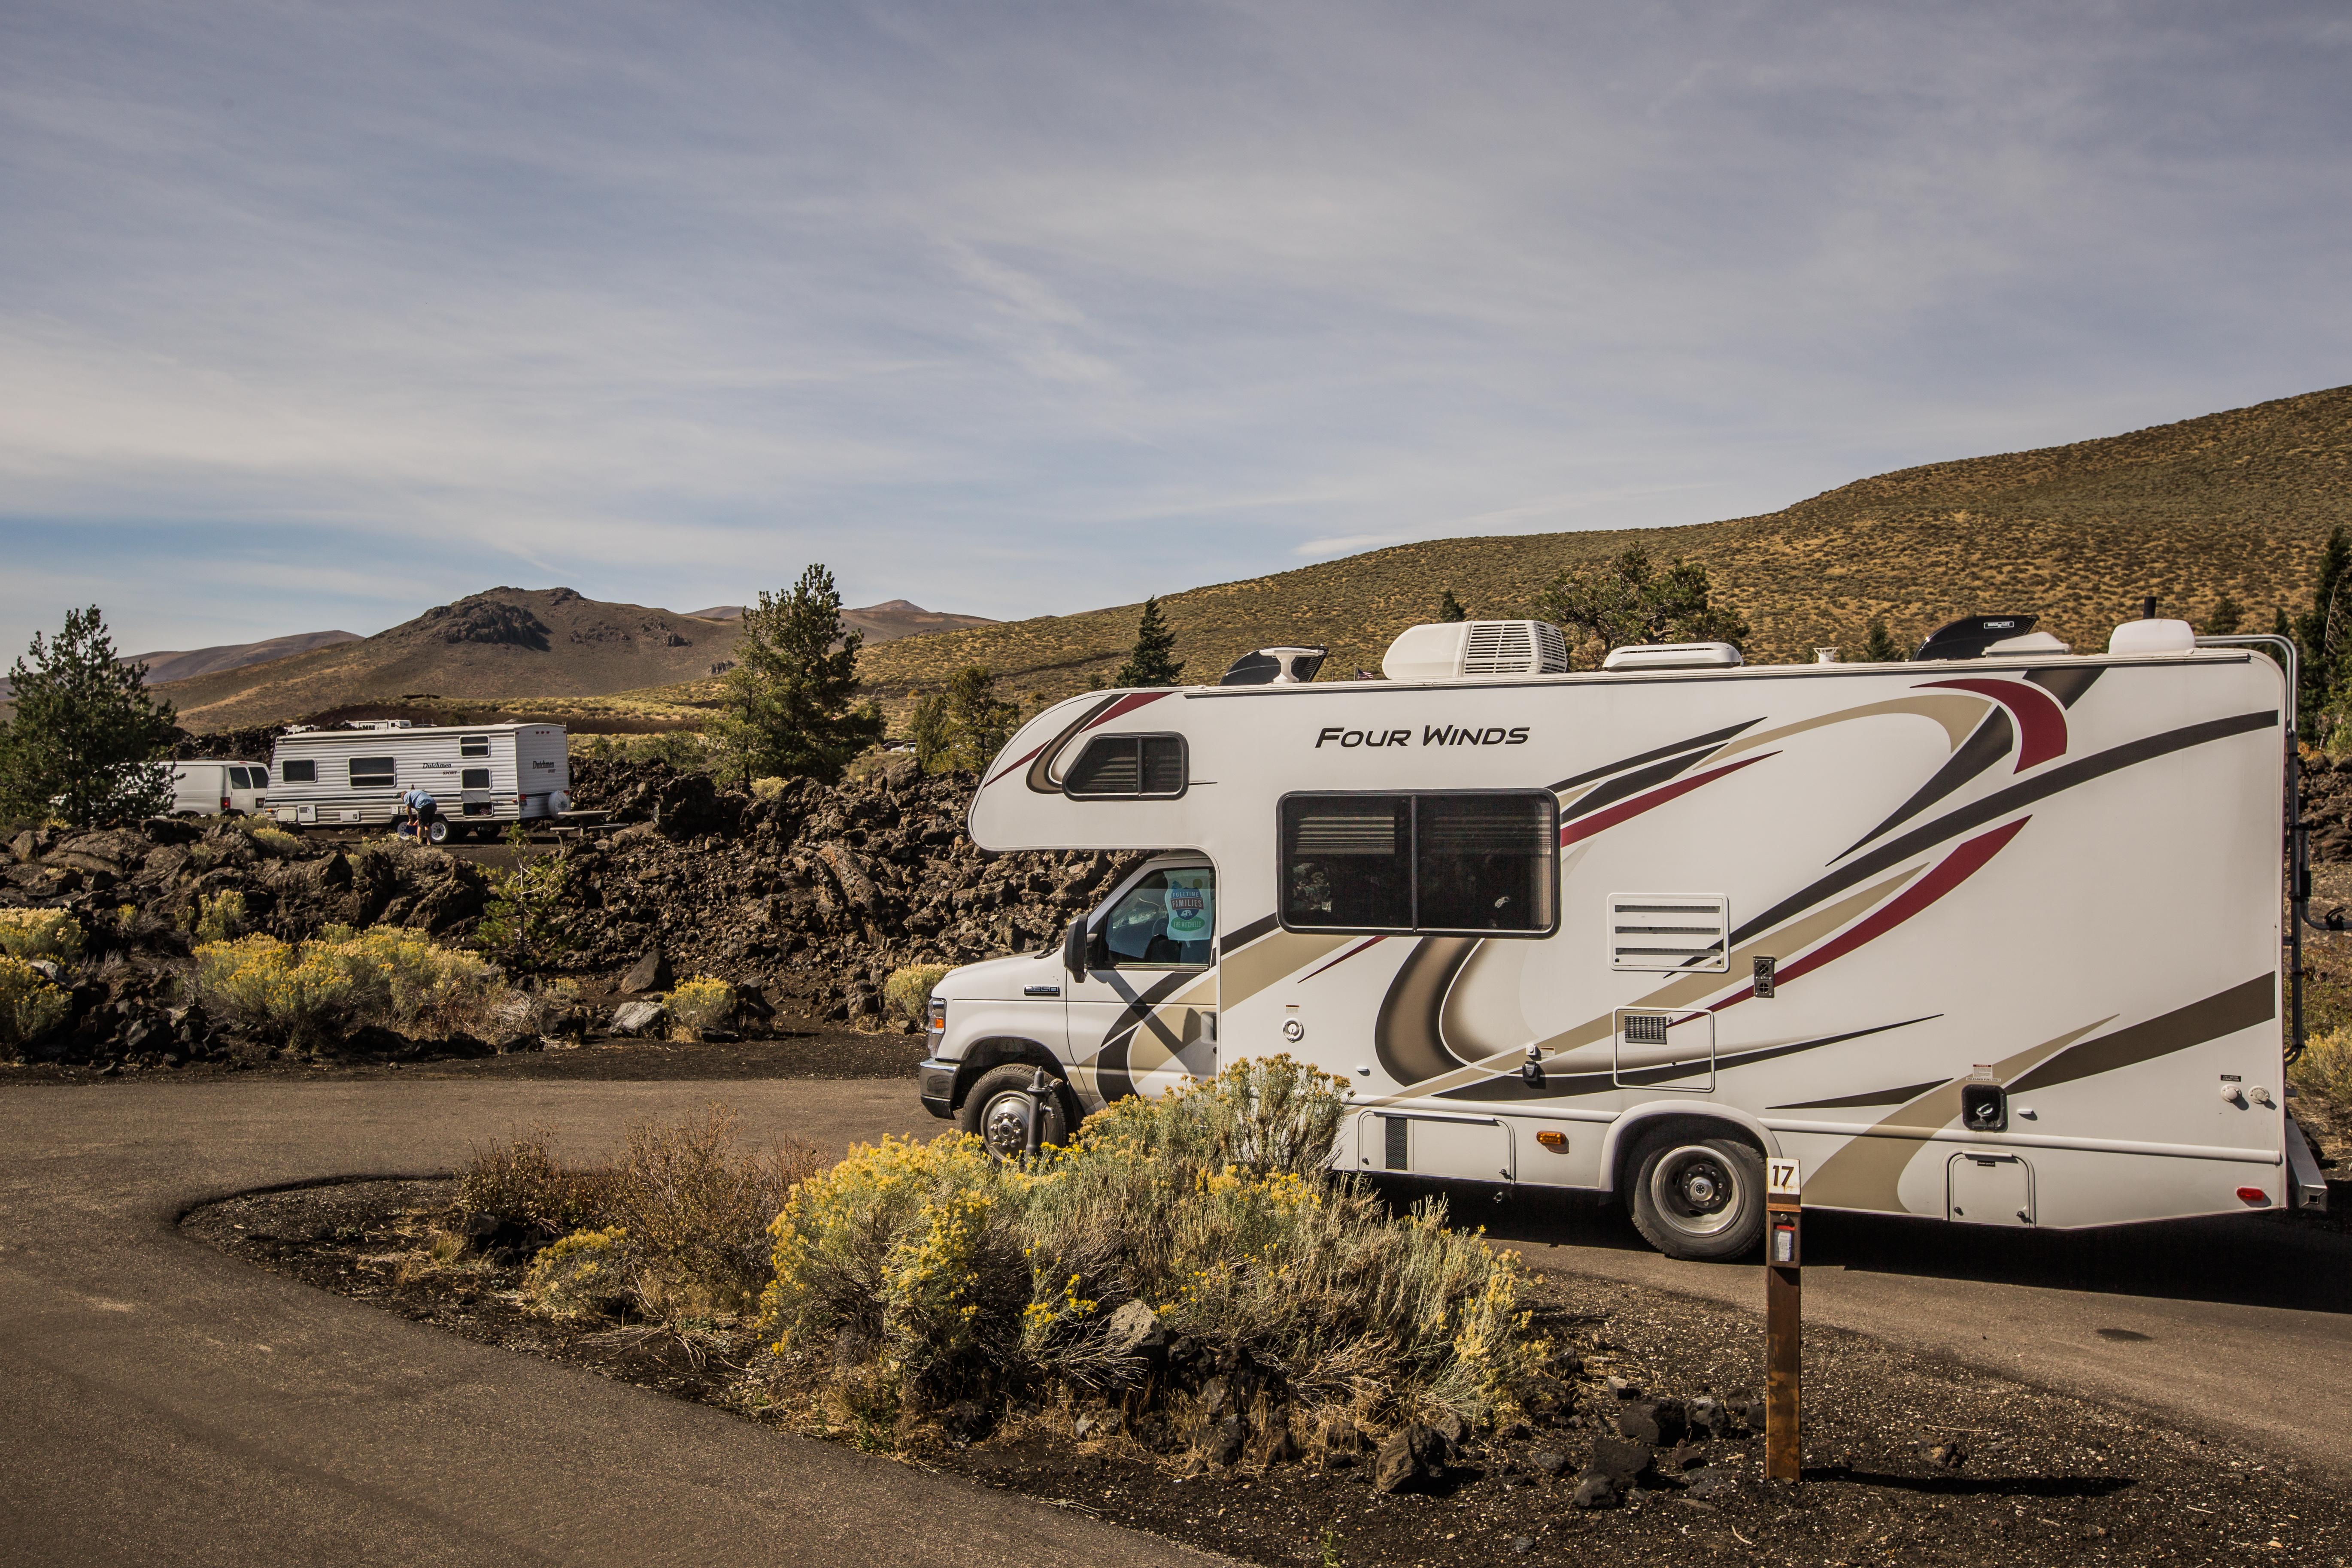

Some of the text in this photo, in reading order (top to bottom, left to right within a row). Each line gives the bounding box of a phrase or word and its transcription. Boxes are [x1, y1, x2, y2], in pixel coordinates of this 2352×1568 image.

[1315, 725, 1530, 748] FOUR WINDS
[532, 760, 554, 769] Dutchmen
[1172, 899, 1202, 908] FAMILIES
[1773, 1165, 1794, 1186] 17
